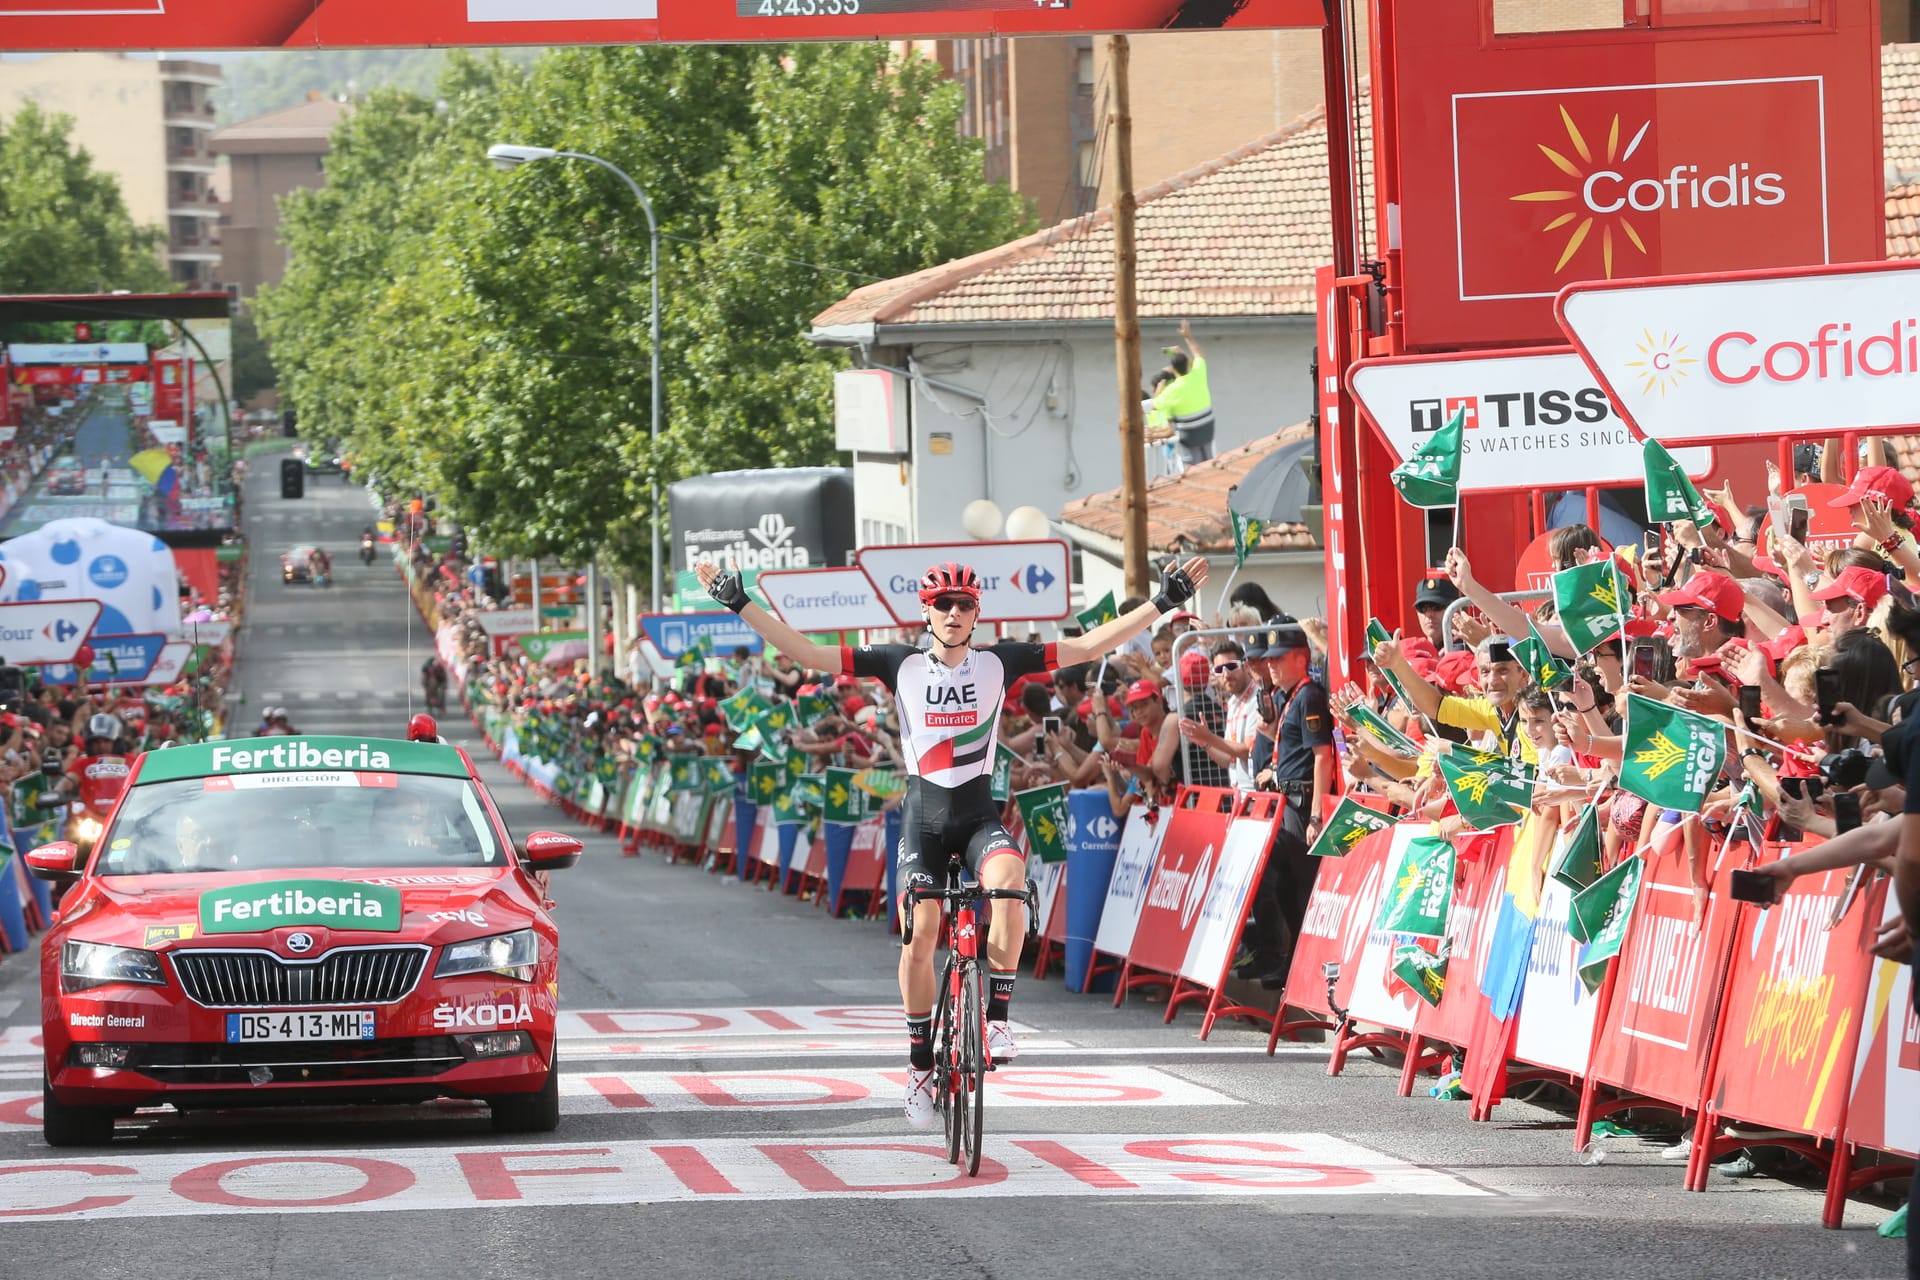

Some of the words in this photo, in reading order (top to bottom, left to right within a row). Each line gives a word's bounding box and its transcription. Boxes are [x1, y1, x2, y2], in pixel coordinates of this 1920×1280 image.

[1583, 163, 1786, 213] Cofidis
[1706, 319, 1918, 384] Cofidi
[1482, 433, 1568, 453] WATCHES
[684, 529, 745, 543] Fertilizantes
[783, 591, 868, 608] Carrefour
[689, 619, 751, 636] LOTERÍA
[925, 684, 977, 705] UAE
[927, 713, 975, 725] Emirates
[213, 742, 391, 771] Fertiberia
[1683, 724, 1698, 793] SEGUROS
[1692, 732, 1717, 794] RGA
[262, 774, 340, 784] DIRECCIÓN
[1426, 850, 1452, 918] RGA
[214, 890, 383, 922] Fertiberia
[426, 909, 489, 928] rtve
[70, 1013, 104, 1027] Director
[107, 1015, 145, 1028] General
[433, 1002, 534, 1028] ŠKODA
[241, 1014, 361, 1039] DS-413-MH
[362, 1026, 374, 1037] 92
